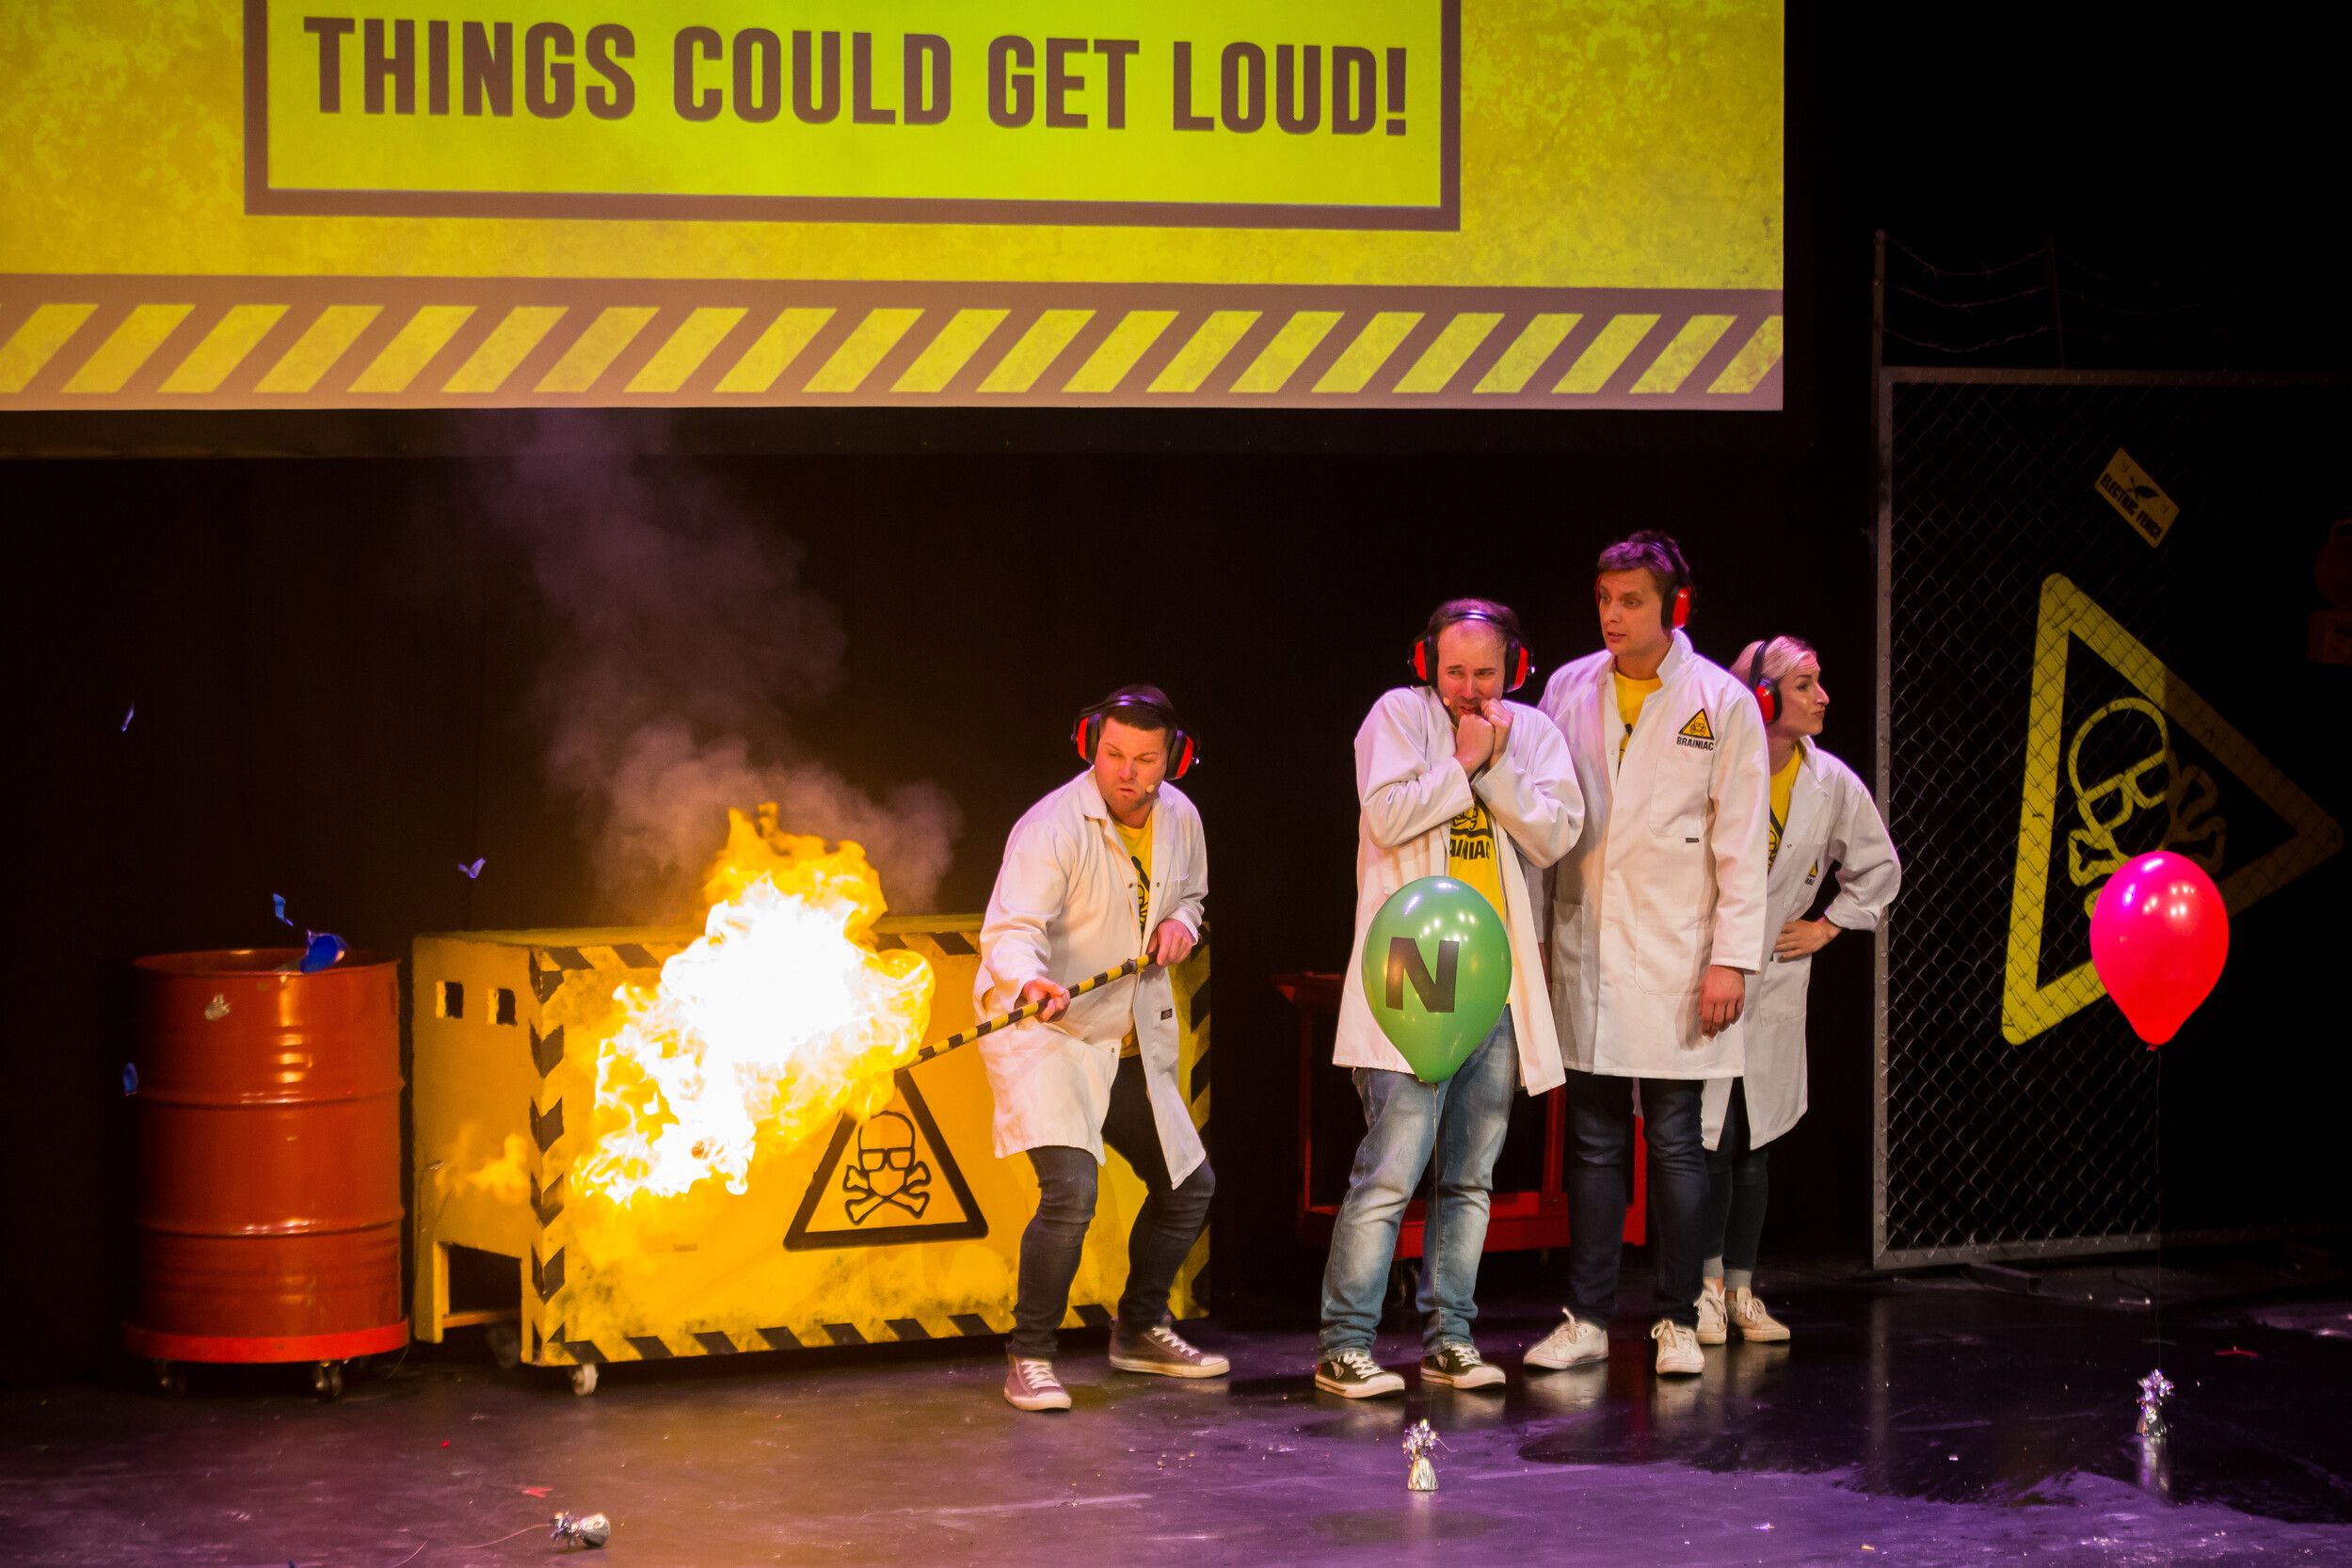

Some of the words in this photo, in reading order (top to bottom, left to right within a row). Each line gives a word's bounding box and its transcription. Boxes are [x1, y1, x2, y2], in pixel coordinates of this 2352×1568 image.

[303, 17, 635, 120] THINGS
[674, 26, 952, 124] COULD
[987, 35, 1140, 130] GET
[1173, 40, 1407, 136] LOUD!
[2100, 472, 2138, 516] ELECTRIC
[1676, 736, 1714, 751] BRAINIAC
[1449, 839, 1491, 860] AINIAC
[1385, 936, 1460, 1014] N
